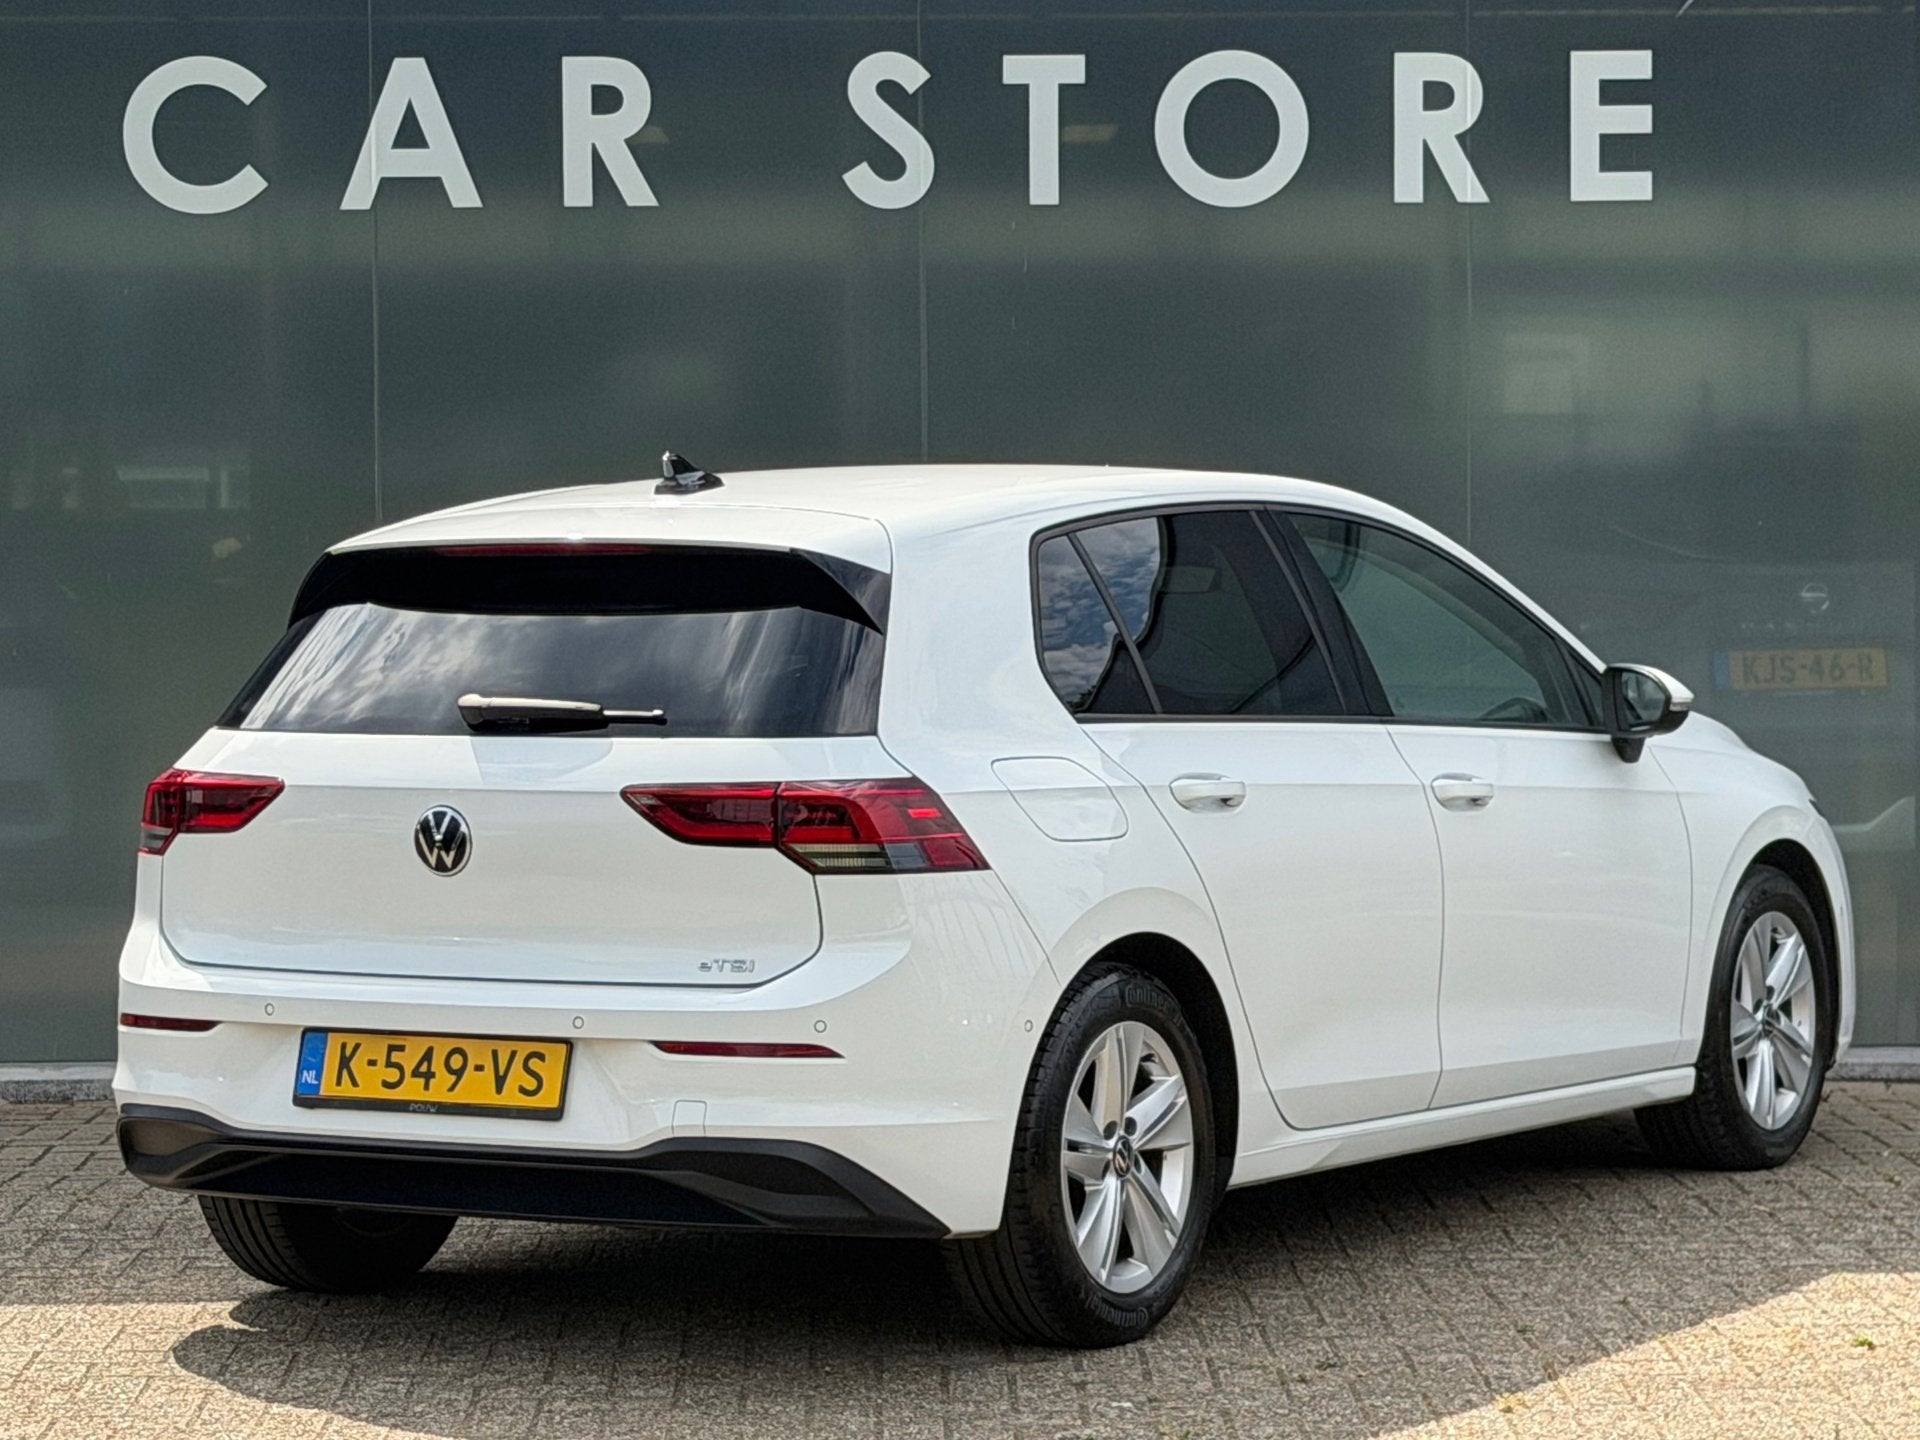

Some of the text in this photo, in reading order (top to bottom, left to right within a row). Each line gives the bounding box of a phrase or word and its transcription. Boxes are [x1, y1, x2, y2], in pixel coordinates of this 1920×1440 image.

[122, 49, 1655, 215] CAR STORE
[301, 1069, 319, 1085] NL
[334, 1041, 547, 1098] K-549-VS
